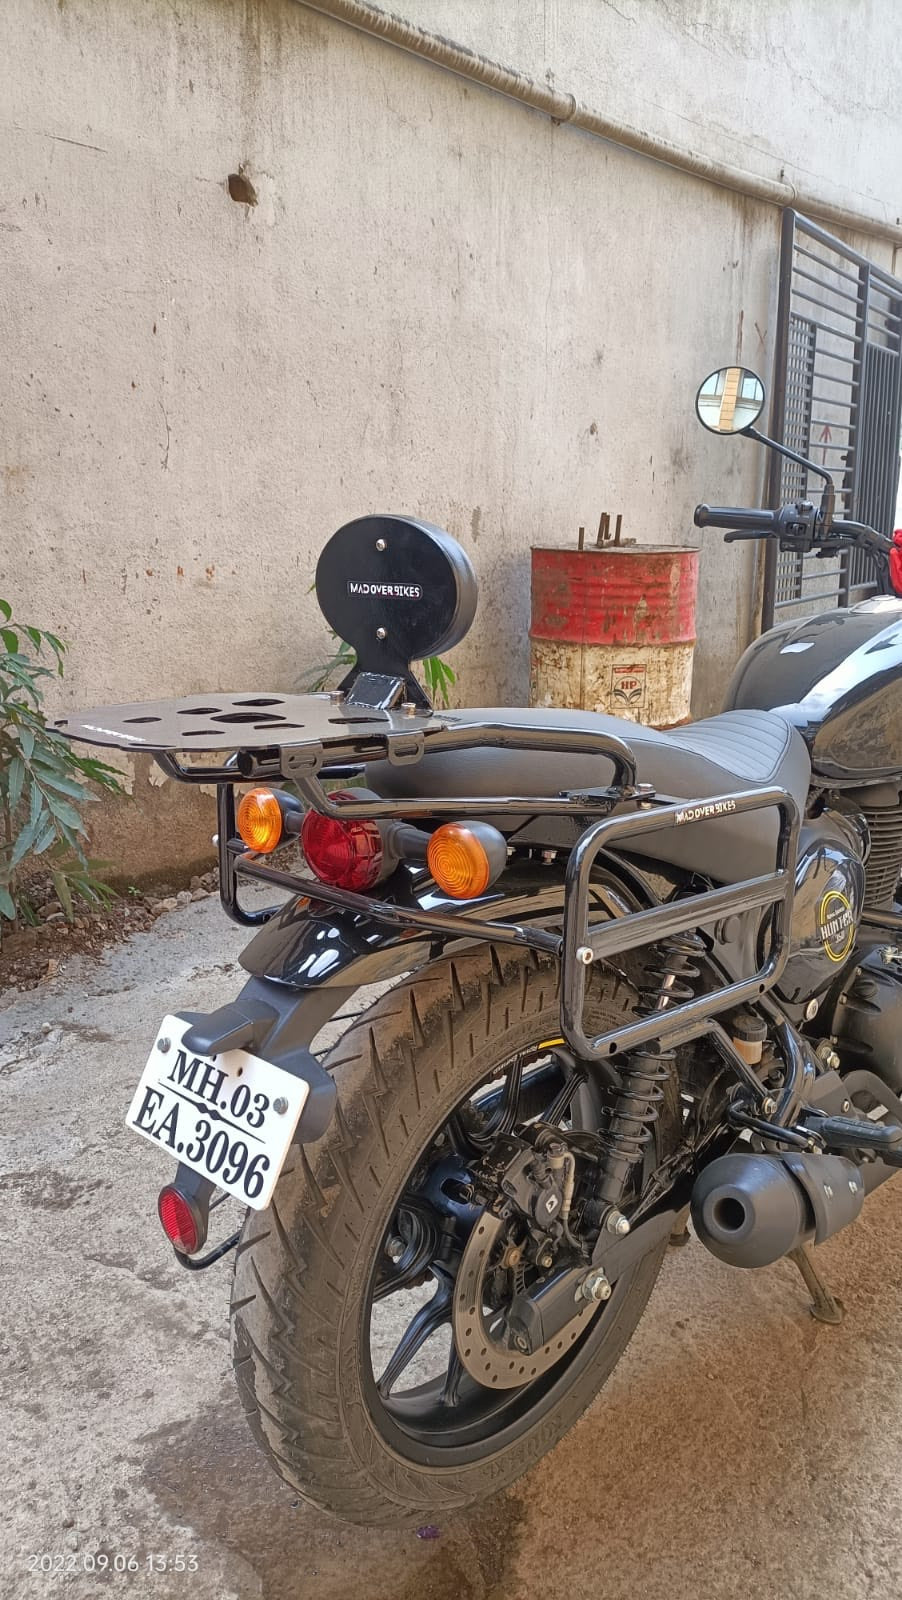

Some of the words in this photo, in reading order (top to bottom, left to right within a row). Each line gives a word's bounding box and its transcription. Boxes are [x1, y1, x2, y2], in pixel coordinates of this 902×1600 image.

[621, 681, 637, 690] HP
[820, 909, 854, 940] HUNTER
[167, 1049, 270, 1128] MH.03
[132, 1086, 270, 1199] EA.3096
